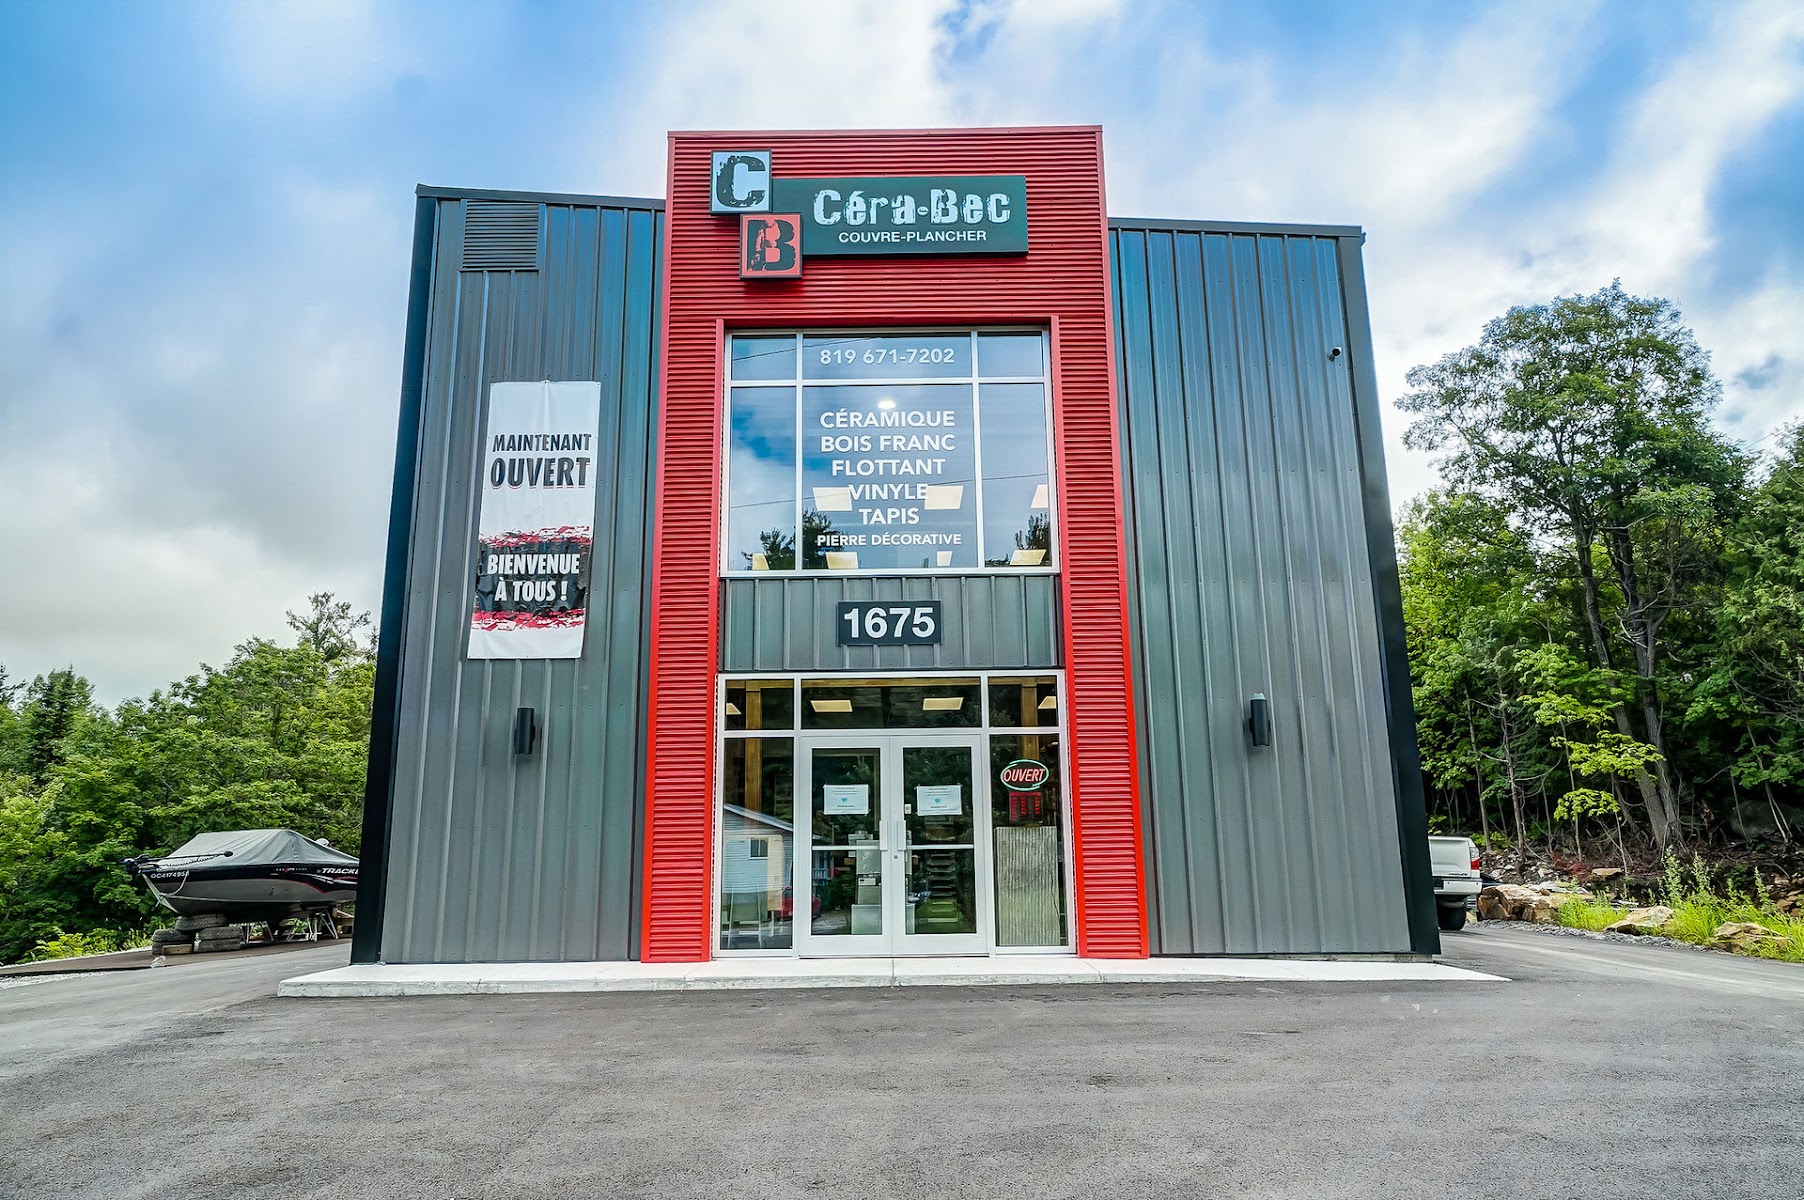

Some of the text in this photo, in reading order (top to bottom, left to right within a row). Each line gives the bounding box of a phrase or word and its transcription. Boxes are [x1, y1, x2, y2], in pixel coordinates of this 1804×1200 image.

[716, 155, 766, 207] C
[747, 219, 797, 271] B
[838, 230, 987, 244] COUVRE-PLANCHER
[820, 348, 955, 365] 819 671-7202
[820, 408, 956, 428] CÉRAMIQUE
[492, 433, 592, 452] MAINTENANT
[821, 434, 956, 452] BOIS FRANC
[490, 457, 591, 488] OUVERT
[832, 459, 946, 476] FLOTTANT
[848, 484, 929, 500] VINYLE
[859, 507, 920, 525] TAPIS
[816, 532, 962, 547] PIERRE DÉCORATIVE
[487, 553, 581, 575] BIENVENUE
[494, 577, 508, 601] À
[513, 580, 557, 601] TOUS
[844, 607, 936, 638] 1675
[1003, 768, 1046, 782] OUVERT
